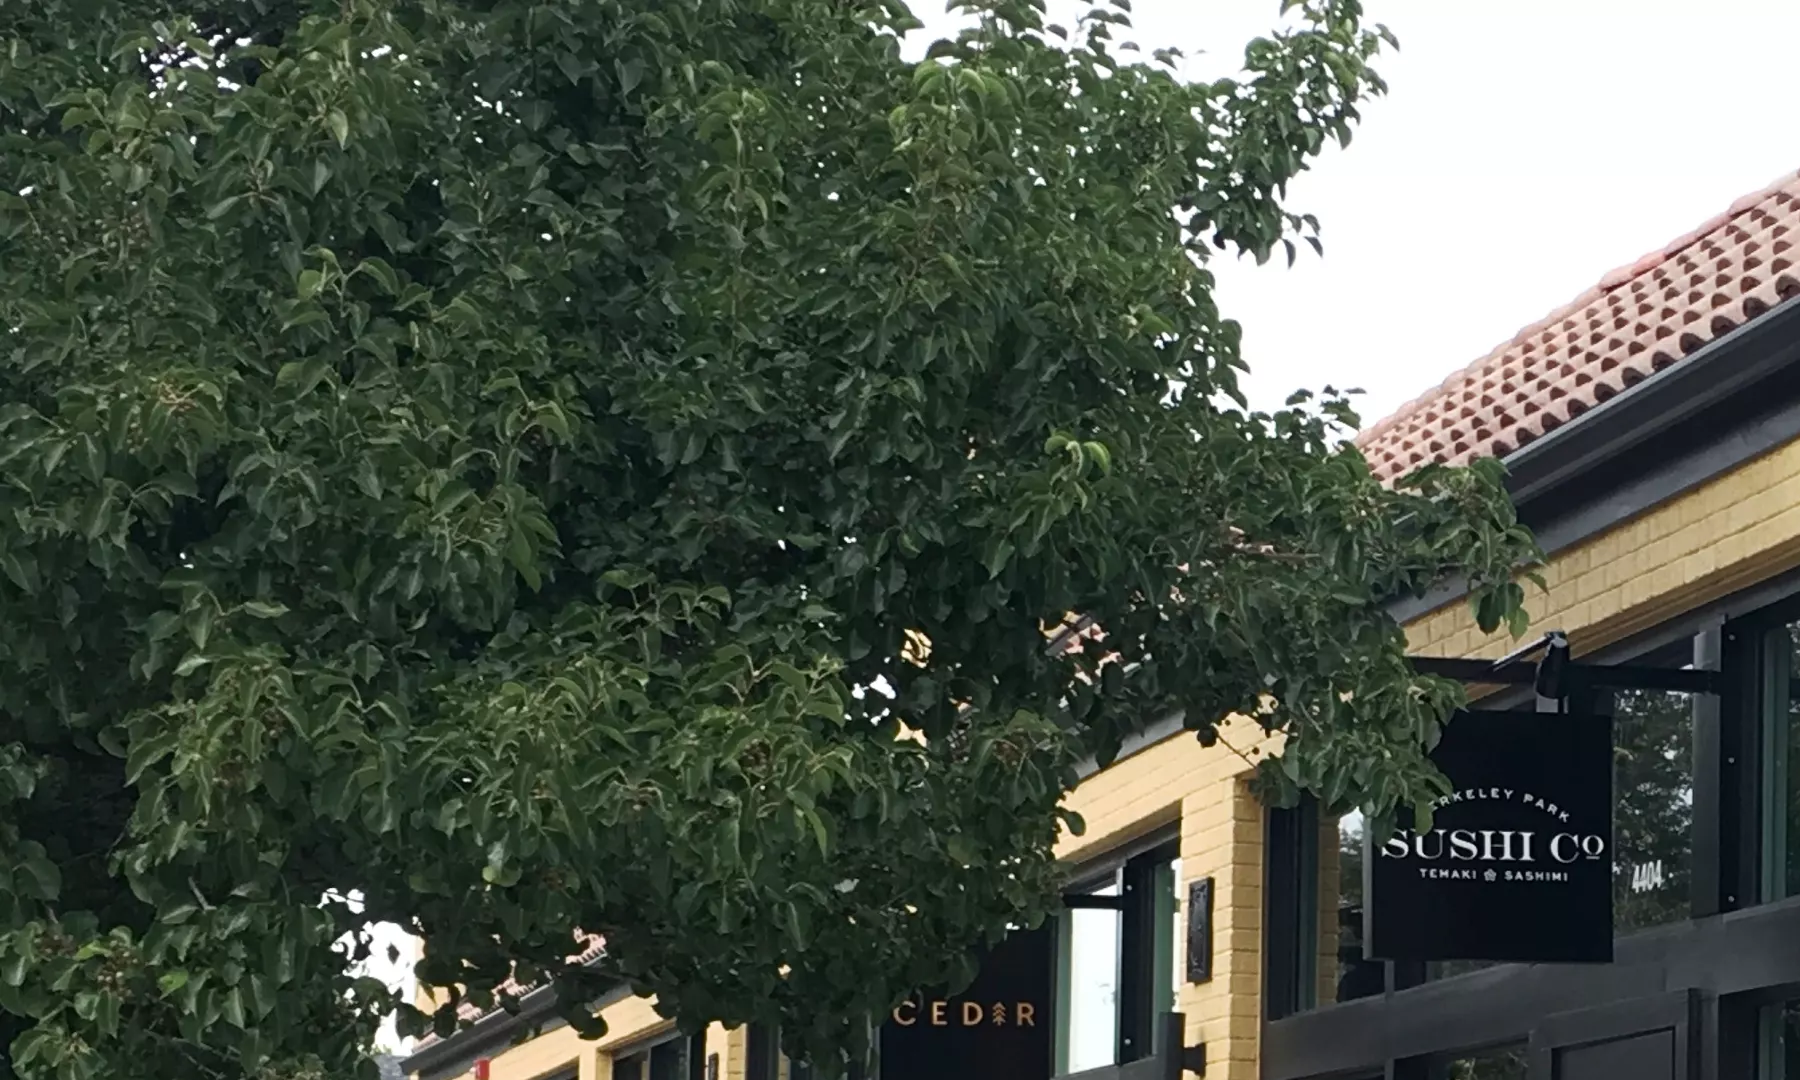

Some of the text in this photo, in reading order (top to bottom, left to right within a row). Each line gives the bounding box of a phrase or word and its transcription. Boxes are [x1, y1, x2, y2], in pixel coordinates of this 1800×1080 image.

[1428, 787, 1570, 823] RKELEY PARK
[1381, 828, 1536, 862] SUSHI
[1419, 868, 1569, 882] TEMAKI SASHIMI
[1631, 859, 1666, 894] 4404
